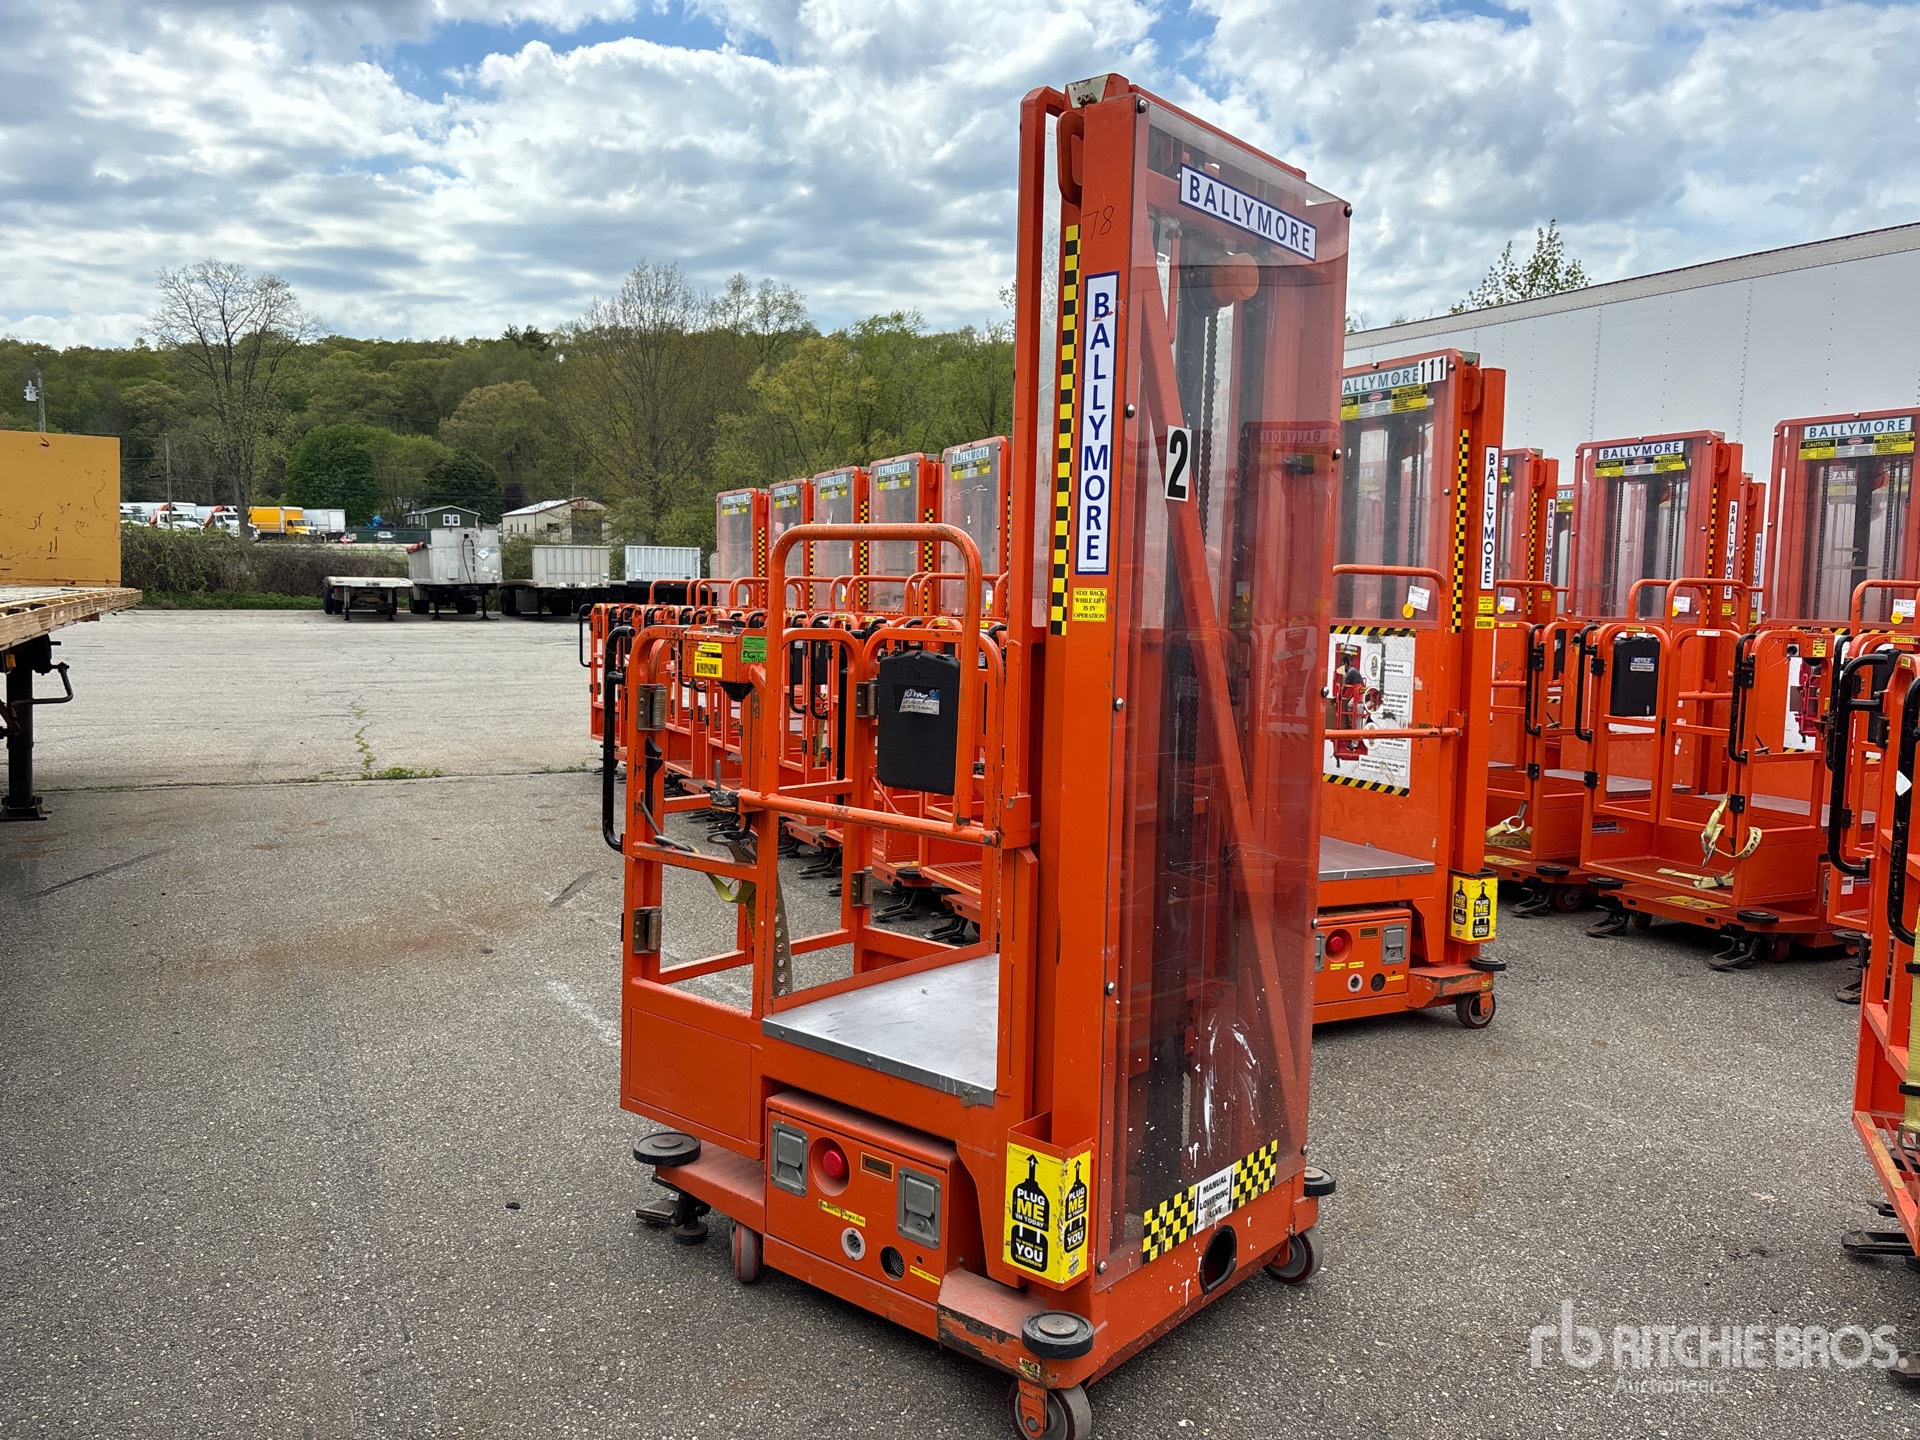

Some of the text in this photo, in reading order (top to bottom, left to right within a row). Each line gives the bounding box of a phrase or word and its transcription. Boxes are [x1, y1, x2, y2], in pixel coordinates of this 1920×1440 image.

[1081, 205, 1115, 240] 78
[1189, 173, 1310, 253] BALLYMORE
[1342, 367, 1419, 393] ALLYMORE
[1421, 357, 1444, 383] 111
[1084, 291, 1111, 560] BALLYMORE
[1809, 418, 1906, 438] BALLYMORE
[953, 447, 988, 464] BALLYMORE
[1602, 442, 1680, 459] BALLYMORE
[1167, 429, 1189, 499] 2
[1483, 453, 1496, 584] BALLYMORE
[1545, 502, 1554, 583] BALLYMORE
[1475, 904, 1489, 913] ME
[1068, 1186, 1085, 1202] PLUG
[1202, 1174, 1227, 1195] MANUAL
[1017, 1187, 1046, 1206] PLUG
[1068, 1194, 1085, 1214] ME
[1199, 1187, 1229, 1211] LOWERING
[1015, 1212, 1045, 1228] IN TODAY
[1016, 1197, 1045, 1222] ME
[1067, 1229, 1084, 1246] YOU
[1015, 1242, 1044, 1263] YOU
[1015, 1253, 1043, 1268] TOMORROW
